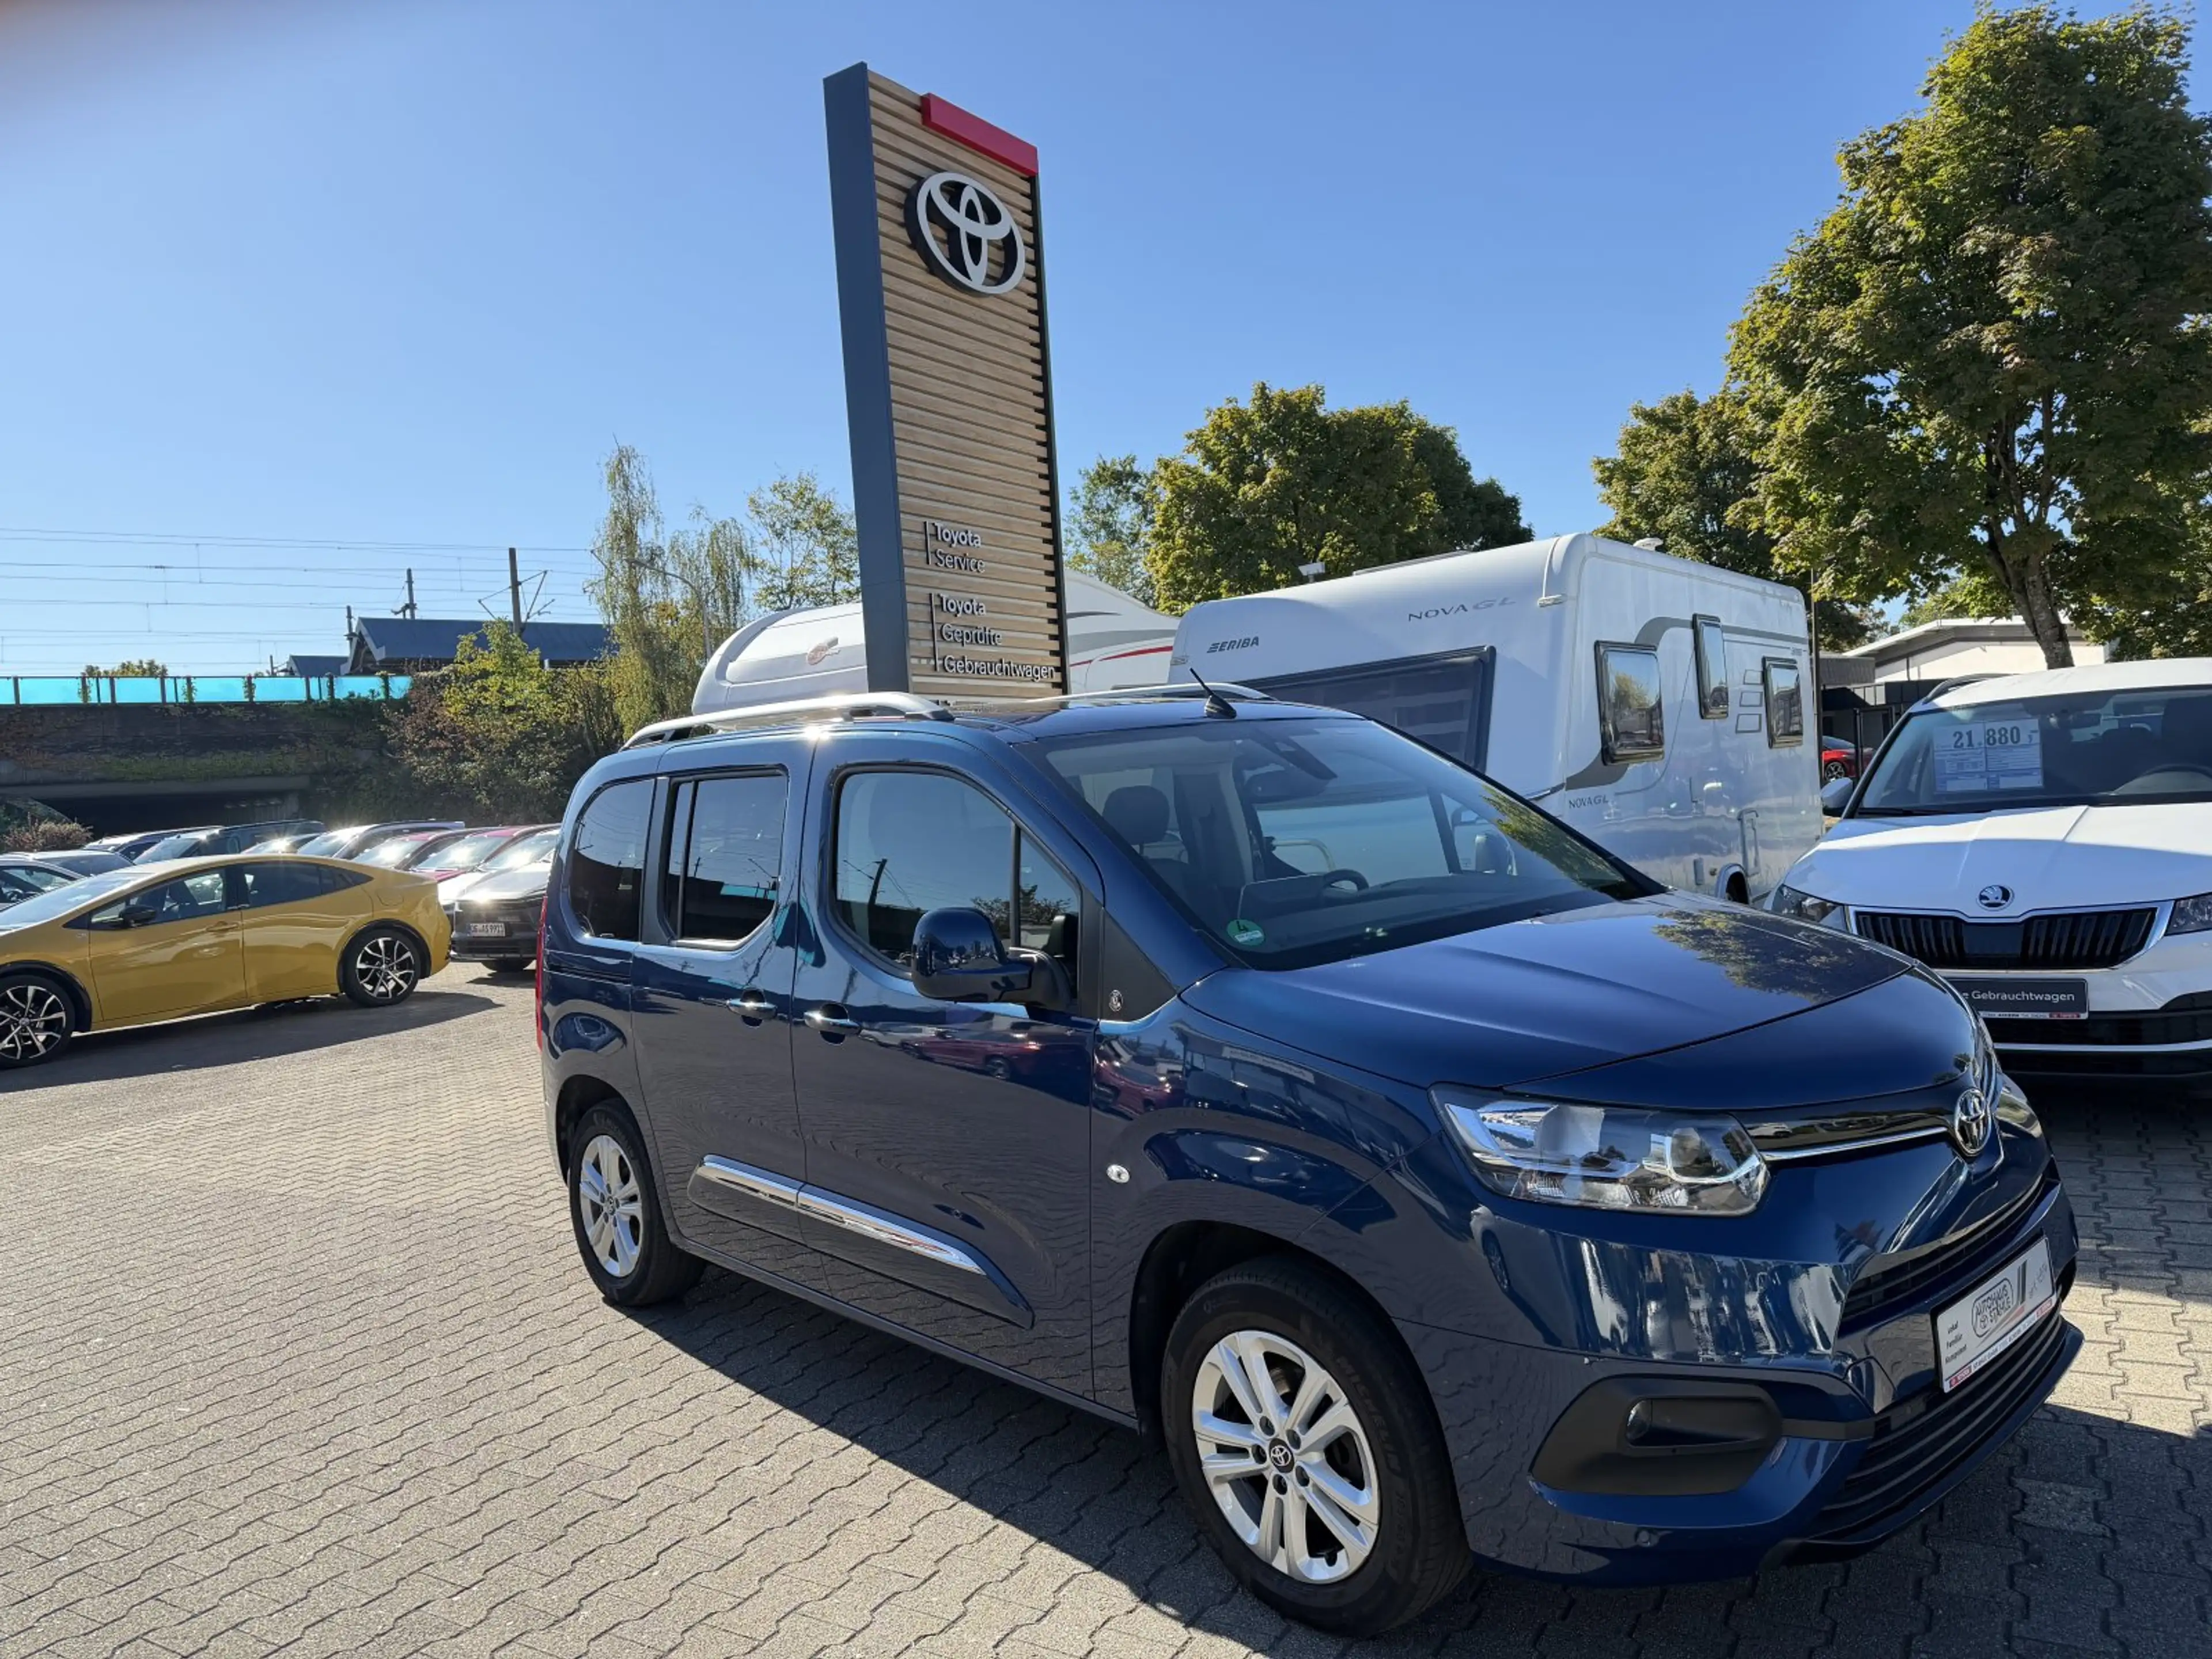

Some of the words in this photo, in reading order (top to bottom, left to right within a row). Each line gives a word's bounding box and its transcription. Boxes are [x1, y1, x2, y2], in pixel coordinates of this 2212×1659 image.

[933, 521, 983, 548] Toyota
[934, 549, 986, 573] Service
[938, 593, 987, 617] Toyota
[1408, 603, 1468, 622] NOVA
[941, 623, 1002, 646] Geprüfte
[1217, 635, 1259, 652] ERIBA
[944, 654, 1055, 682] Gebrauchtwagen
[1236, 920, 1250, 932] 4
[1971, 990, 2075, 1003] Gebrauchtwagen
[1335, 1355, 1402, 1471] MICHELIN
